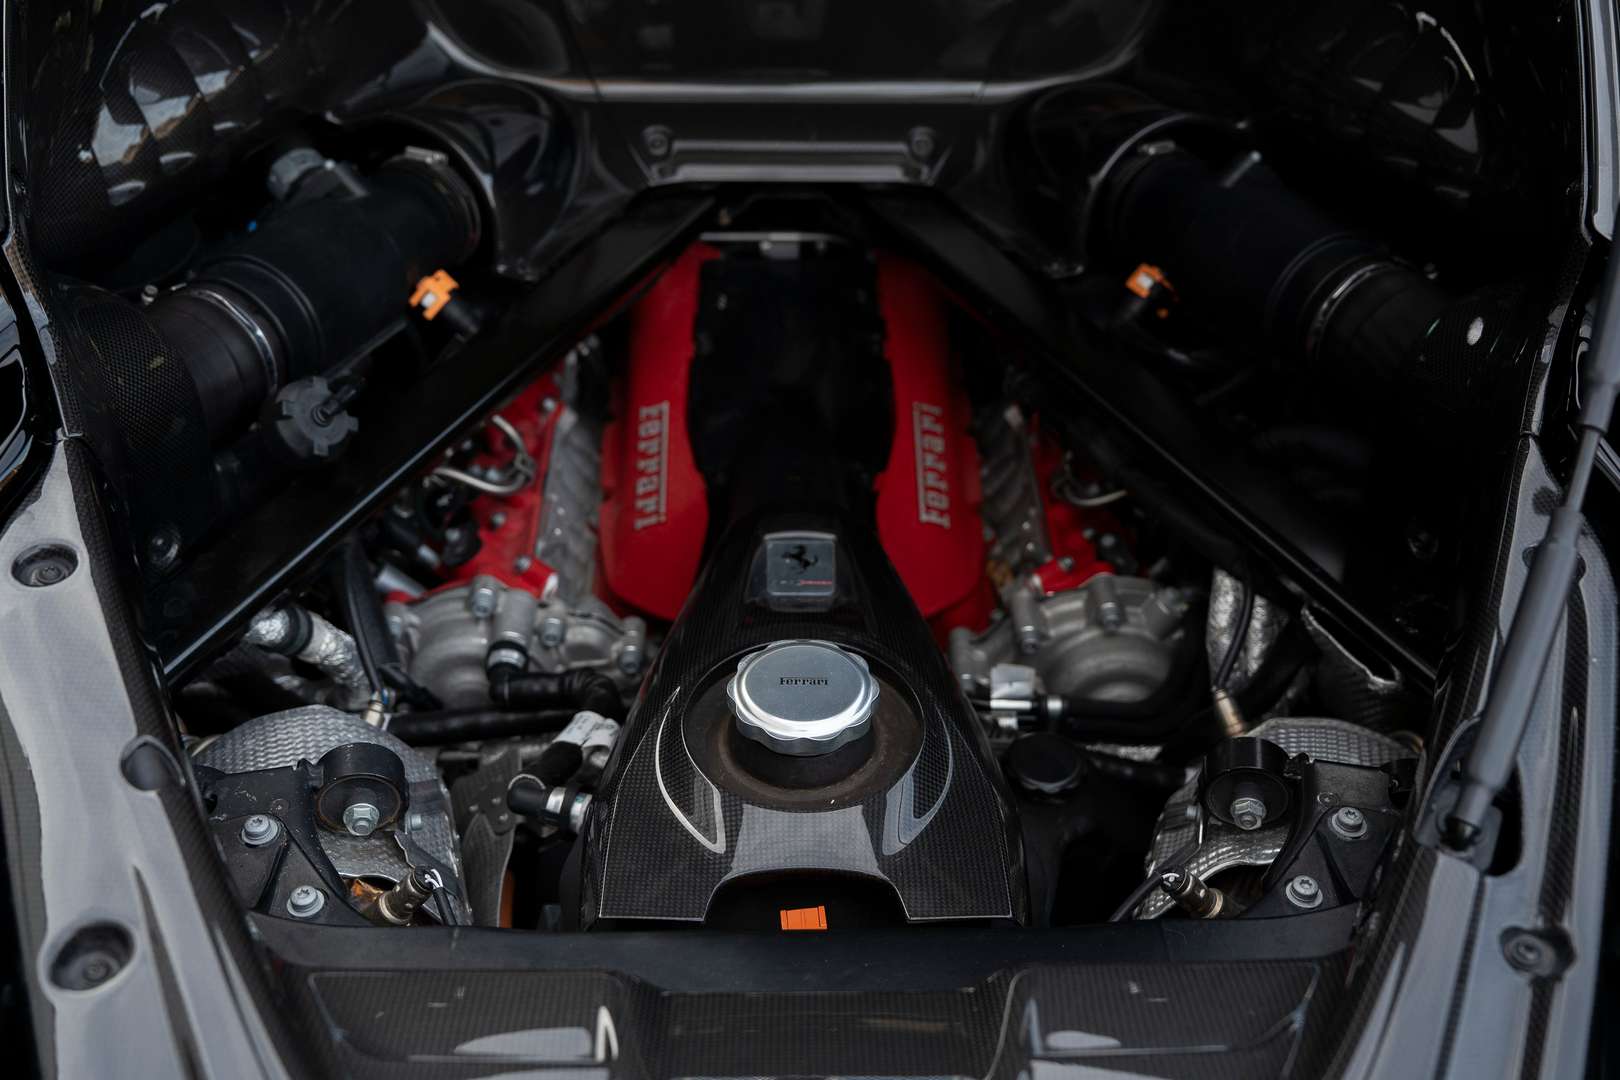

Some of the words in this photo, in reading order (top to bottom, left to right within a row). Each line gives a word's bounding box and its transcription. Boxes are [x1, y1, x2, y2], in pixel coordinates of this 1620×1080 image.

[633, 400, 671, 531] Ferrari
[912, 400, 951, 530] Ferrari
[780, 676, 828, 686] Ferrari
